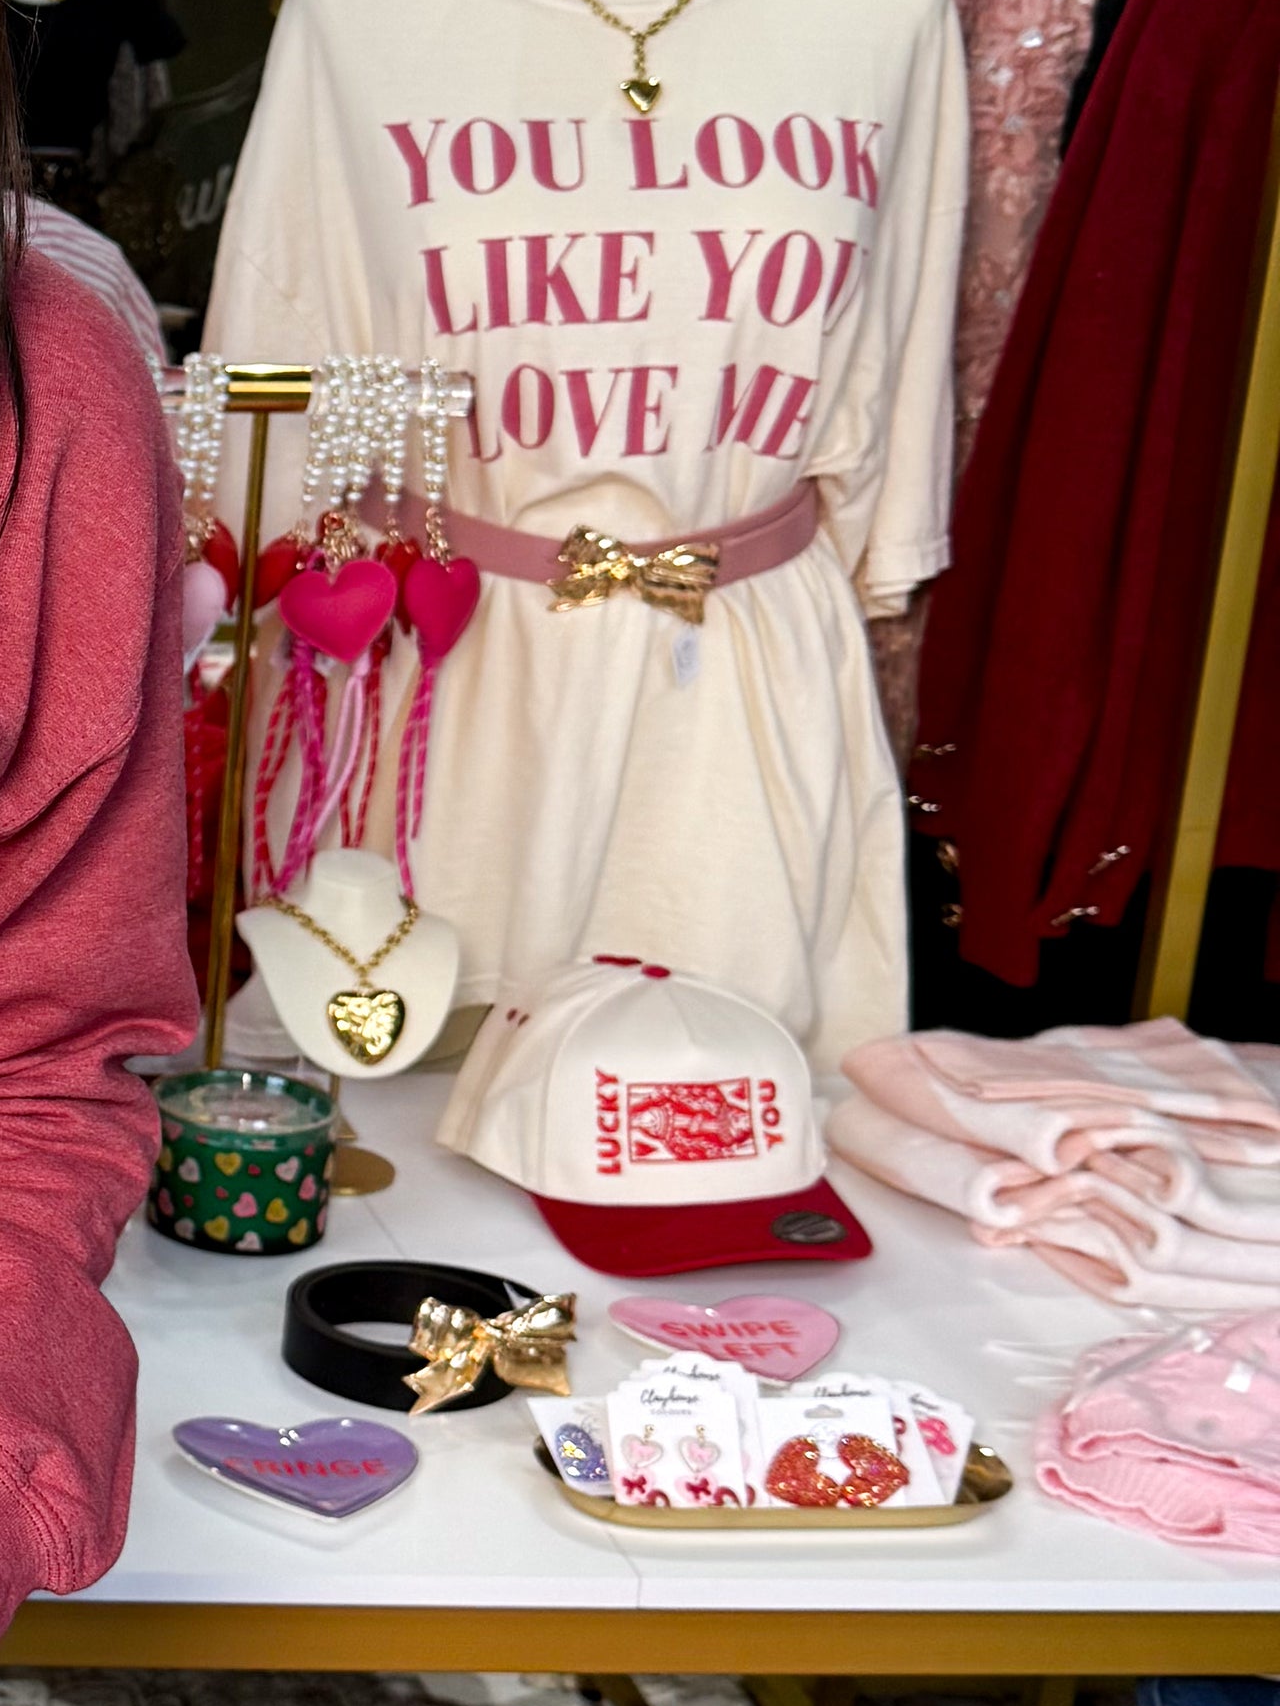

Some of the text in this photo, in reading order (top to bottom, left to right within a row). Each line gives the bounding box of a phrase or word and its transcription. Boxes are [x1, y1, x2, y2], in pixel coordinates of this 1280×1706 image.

[382, 112, 883, 210] YOU LOOK
[419, 229, 870, 337] LIKE YOU
[464, 362, 820, 463] LOVE ME
[594, 1066, 624, 1176] LUCKY
[757, 1078, 785, 1153] YOU
[660, 1319, 801, 1339] SWIPE
[223, 1456, 390, 1479] CRINGE
